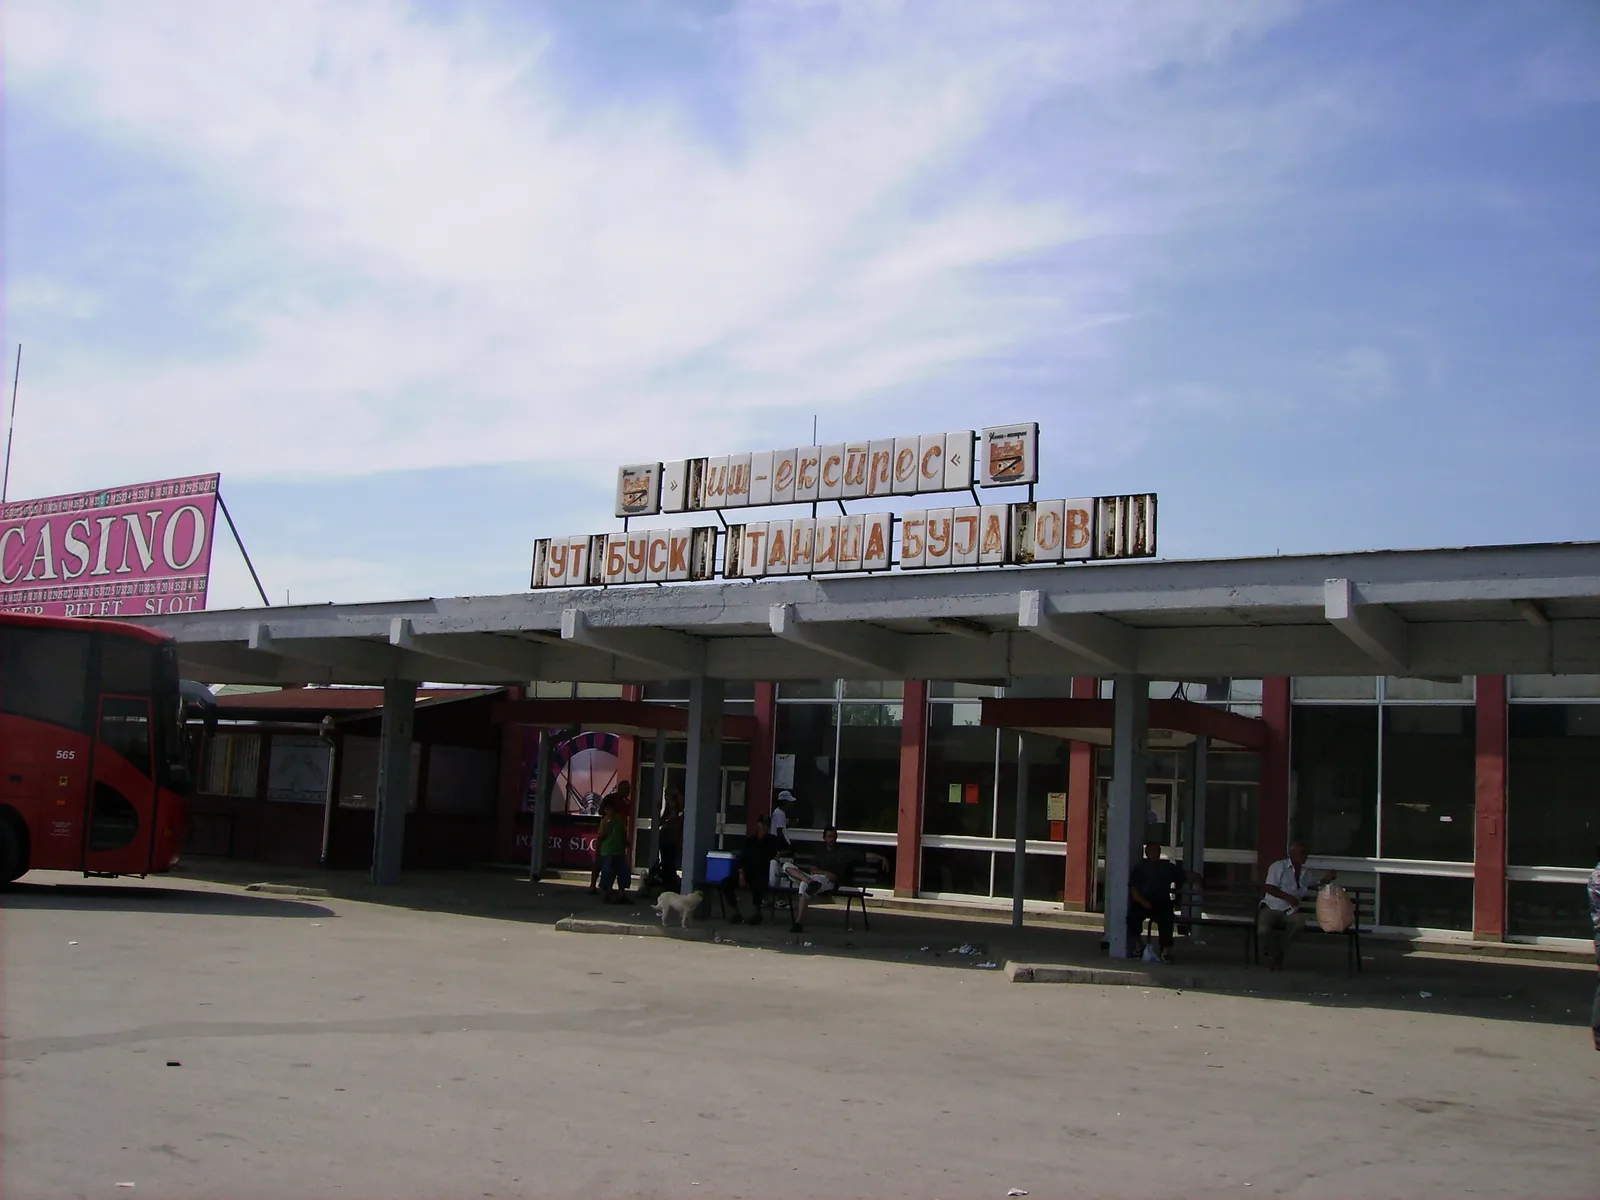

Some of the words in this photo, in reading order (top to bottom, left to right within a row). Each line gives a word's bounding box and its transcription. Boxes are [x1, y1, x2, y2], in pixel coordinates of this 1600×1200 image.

[0, 505, 206, 585] CASINO
[144, 596, 197, 615] SLOT
[56, 749, 76, 760] 565
